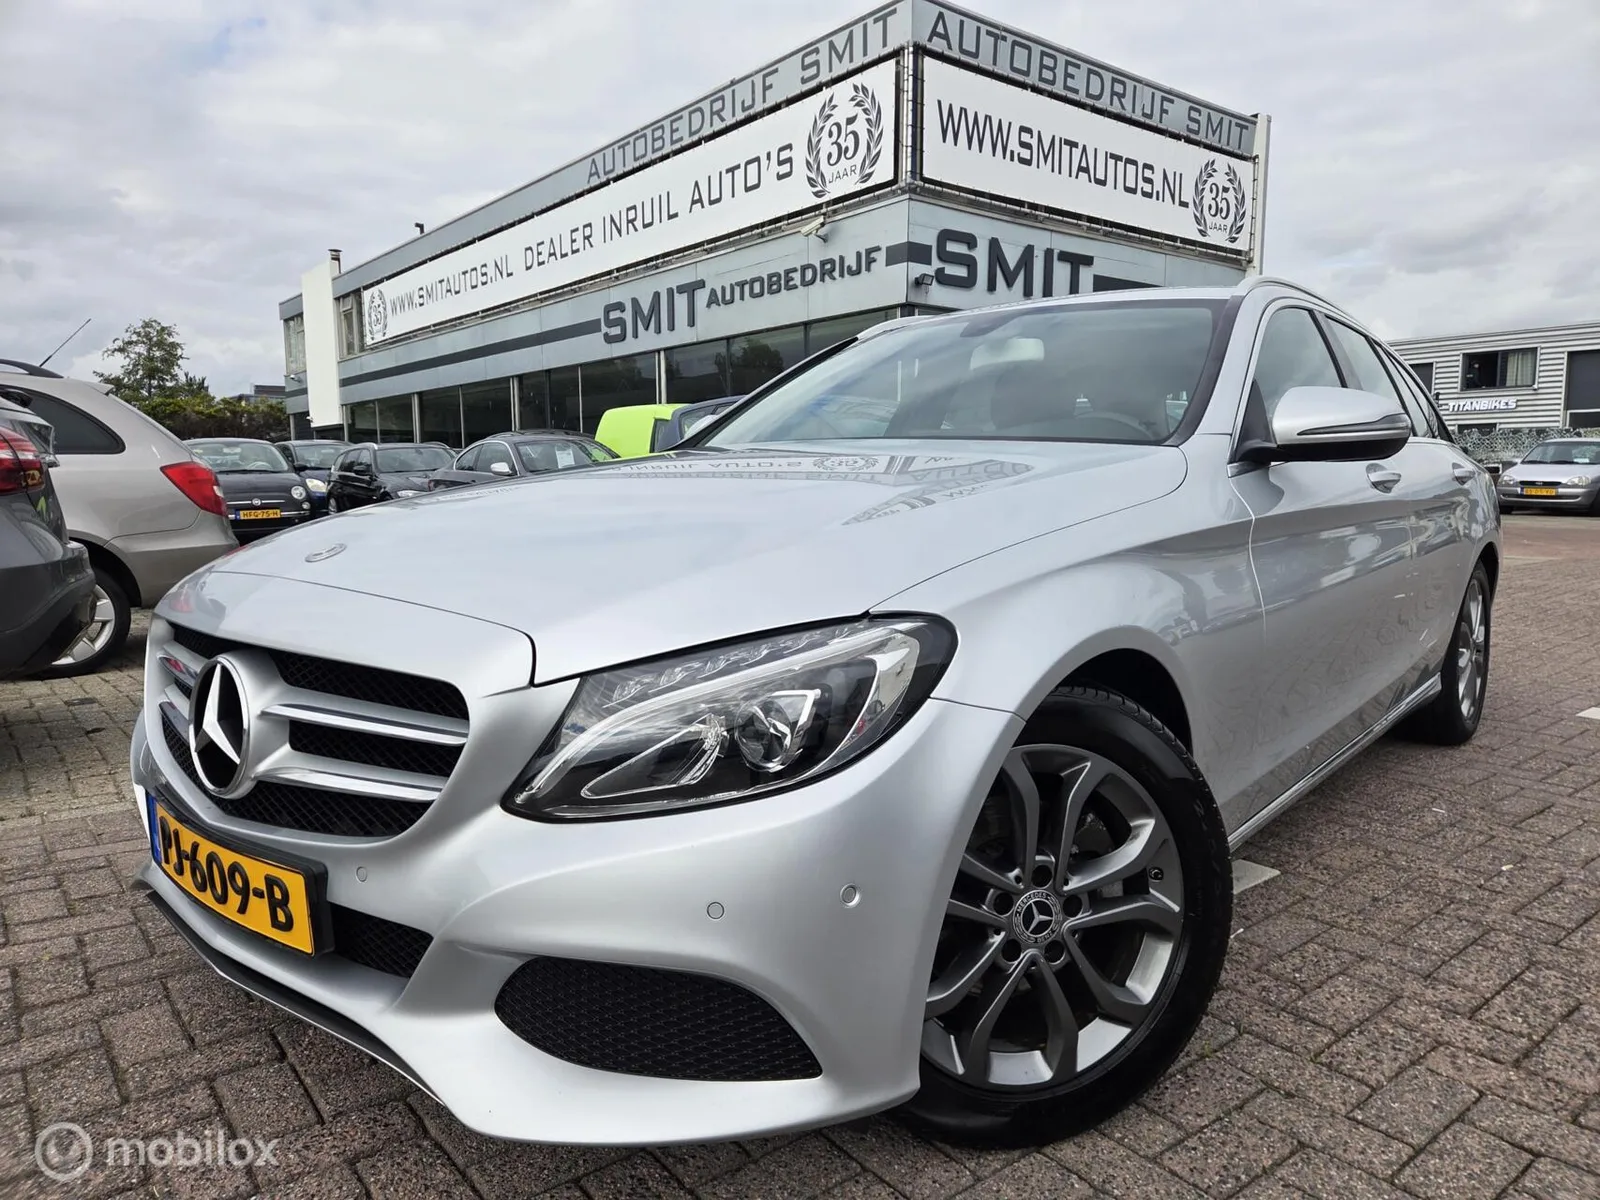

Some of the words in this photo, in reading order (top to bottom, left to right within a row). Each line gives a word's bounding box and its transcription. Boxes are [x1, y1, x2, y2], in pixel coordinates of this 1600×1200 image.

[587, 67, 779, 184] AUTOBEDRIJF
[800, 7, 897, 85] SMIT
[927, 11, 1175, 124] AUTOBEDRIJF
[1186, 106, 1249, 150] SMIT
[826, 113, 861, 166] 35
[828, 164, 857, 184] JAAR
[937, 99, 1190, 209] WWW.SMITAUTOS.NL
[390, 254, 513, 317] WWW.SMITAUTOS.NL
[524, 222, 594, 271] DEALER
[602, 190, 679, 244] INRUIL
[688, 142, 794, 213] AUTO'S
[1207, 180, 1231, 221] 35
[1208, 222, 1228, 234] JAAR
[602, 279, 706, 344] SMIT
[705, 245, 882, 309] AUTOBEDRIJF
[935, 228, 1094, 298] SMIT
[1447, 398, 1517, 412] TITANBIKES
[158, 816, 295, 932] PJ-609-B
[1016, 892, 1047, 912] MERCEDES
